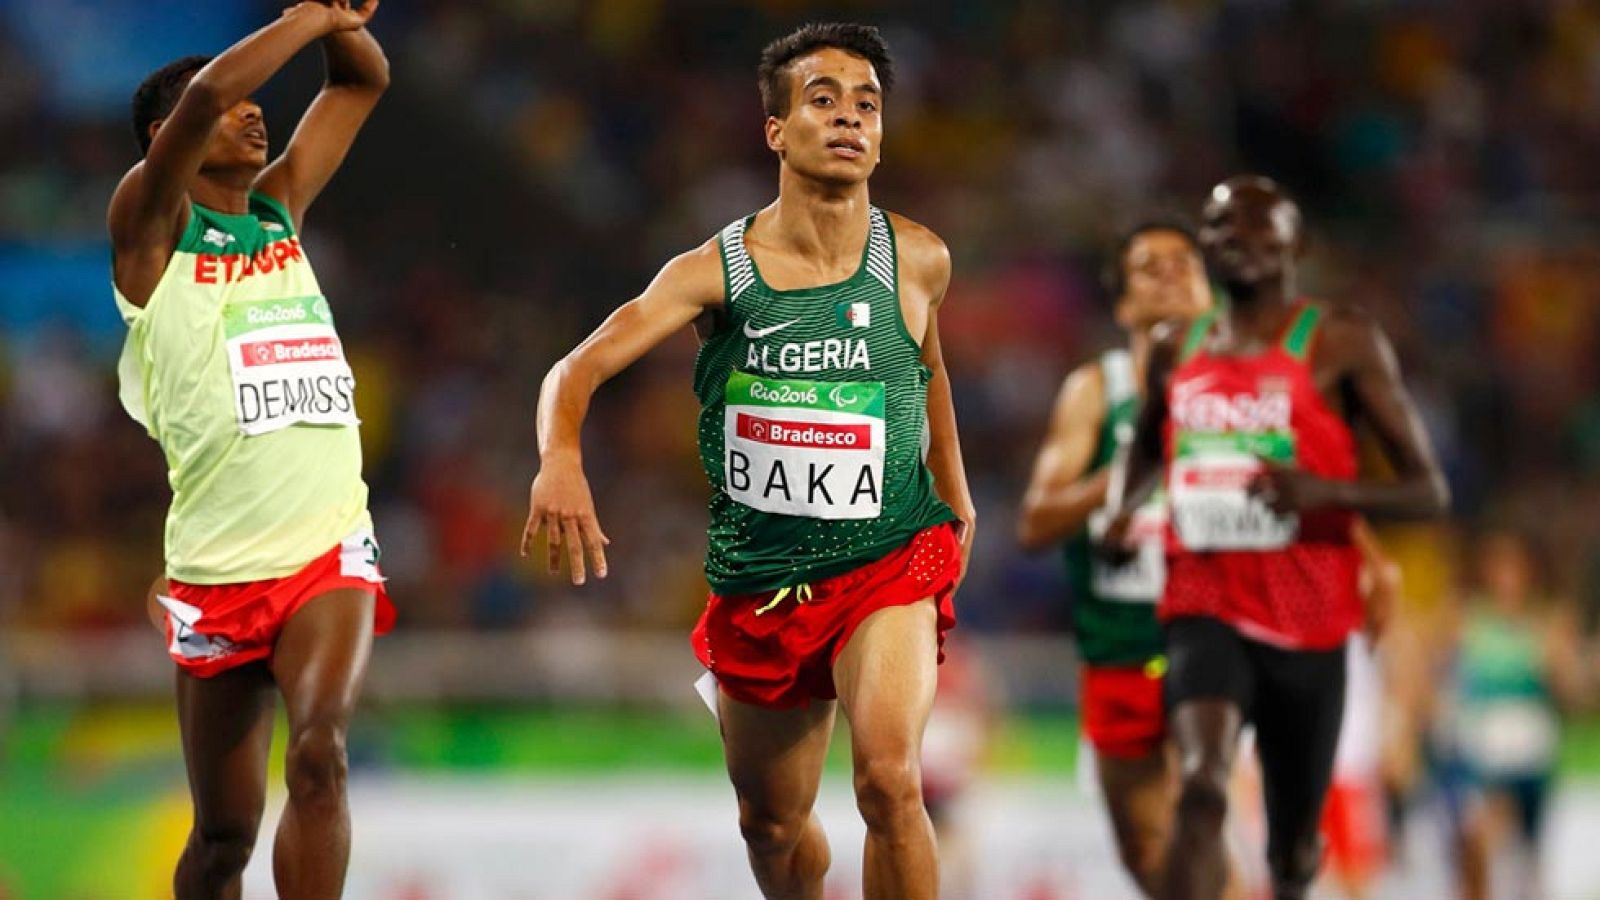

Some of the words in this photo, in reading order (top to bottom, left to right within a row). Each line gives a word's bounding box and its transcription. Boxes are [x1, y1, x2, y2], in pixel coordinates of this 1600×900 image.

[745, 338, 871, 373] ALGERIA
[239, 374, 355, 424] DEMISS
[750, 381, 818, 404] Rio2016
[770, 425, 857, 445] Bradesco
[730, 450, 878, 505] BAKA
